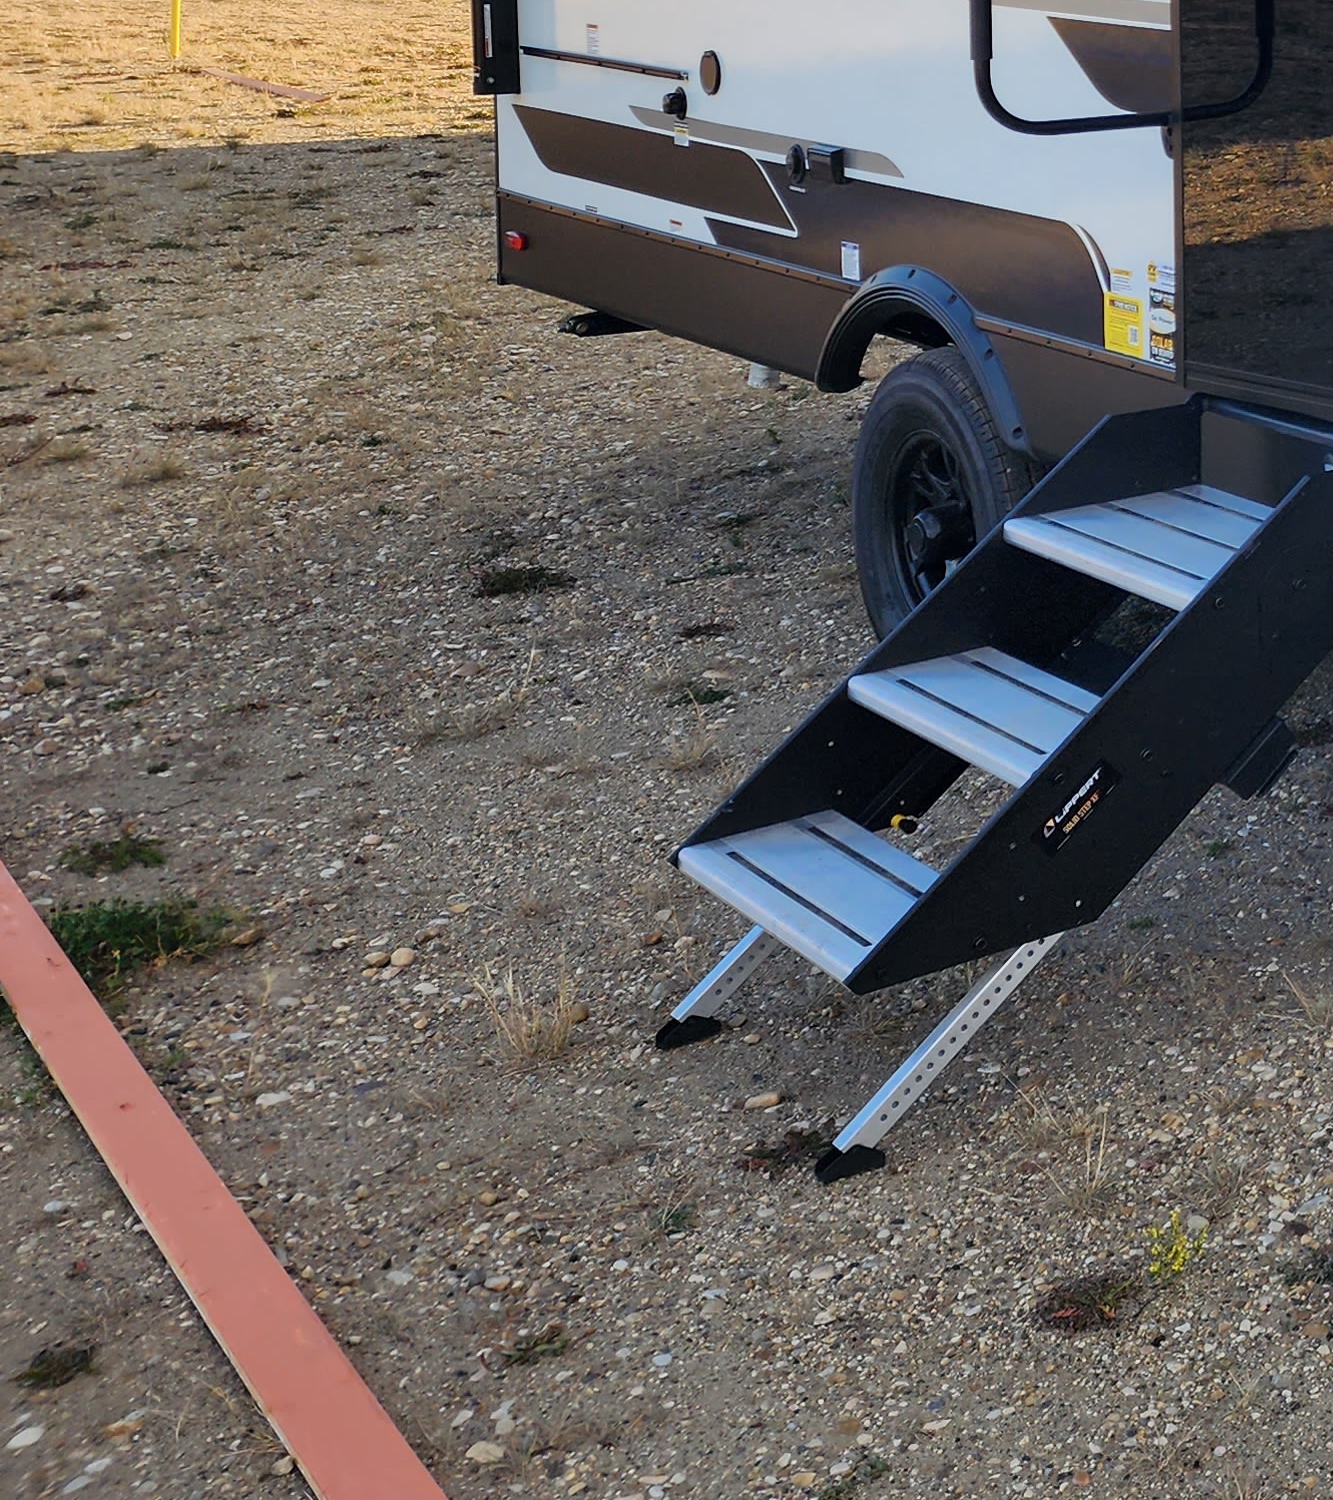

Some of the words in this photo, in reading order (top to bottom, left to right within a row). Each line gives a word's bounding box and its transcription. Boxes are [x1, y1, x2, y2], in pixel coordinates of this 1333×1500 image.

[1055, 767, 1102, 823] LIPPERT
[1062, 815, 1080, 834] SOLID
[1077, 800, 1092, 818] STEP
